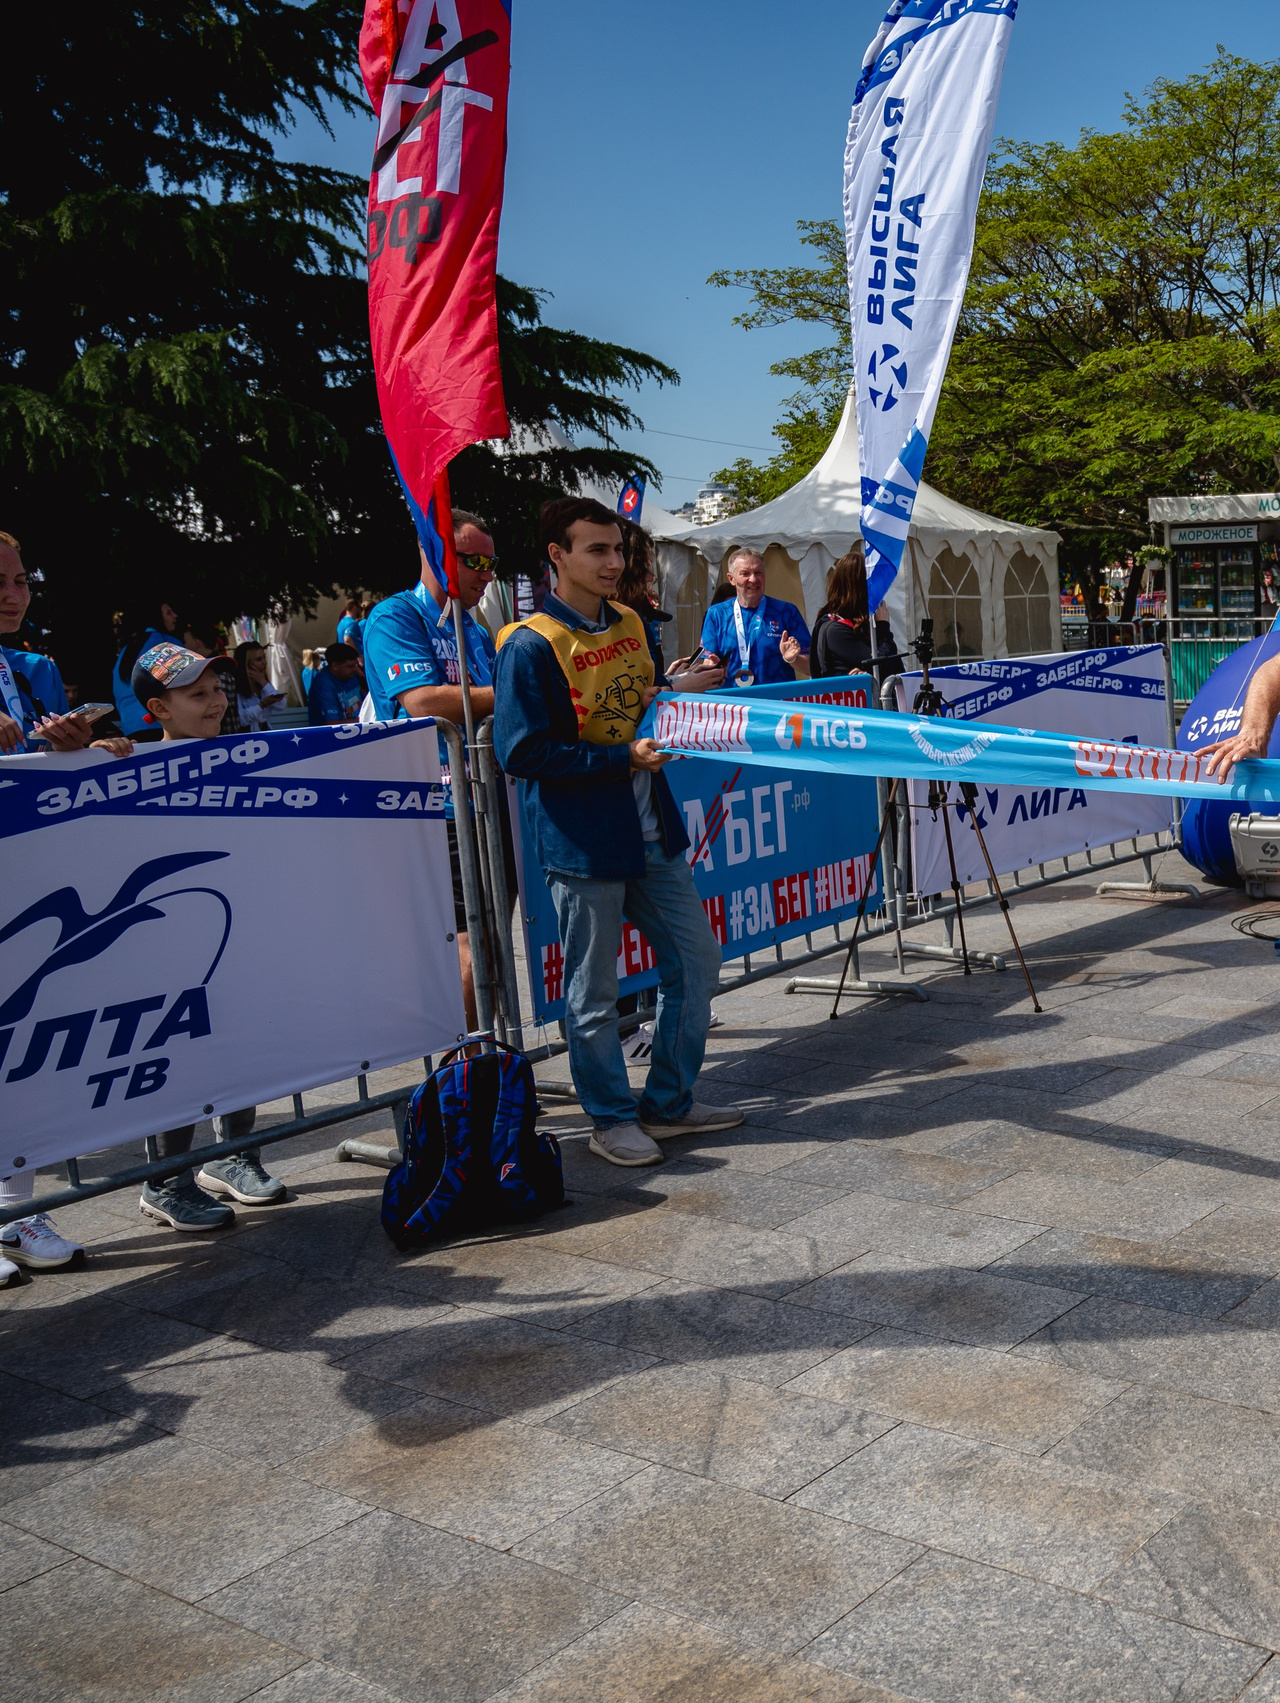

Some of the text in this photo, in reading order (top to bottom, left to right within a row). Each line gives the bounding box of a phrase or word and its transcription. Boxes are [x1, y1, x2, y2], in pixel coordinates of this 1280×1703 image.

[867, 96, 906, 326] ВЫСШАЯ
[891, 193, 926, 332] ЛИГА
[1178, 527, 1253, 542] МОРОЖЕНОЕ
[404, 662, 432, 674] ПСБ
[958, 663, 1033, 679] ЗАБЕГ.Р
[1036, 652, 1107, 688] ЗАБЕГ.РФ
[945, 686, 1013, 719] АБЕГ.РФ
[811, 718, 867, 750] ПСБ
[36, 739, 271, 816] ЗАБЕГ.РФ
[1007, 788, 1088, 826] ЛИГА
[681, 780, 793, 876] АБЕГ
[730, 872, 813, 941] #ЗАБЕГ
[86, 1057, 171, 1110] ТВ
